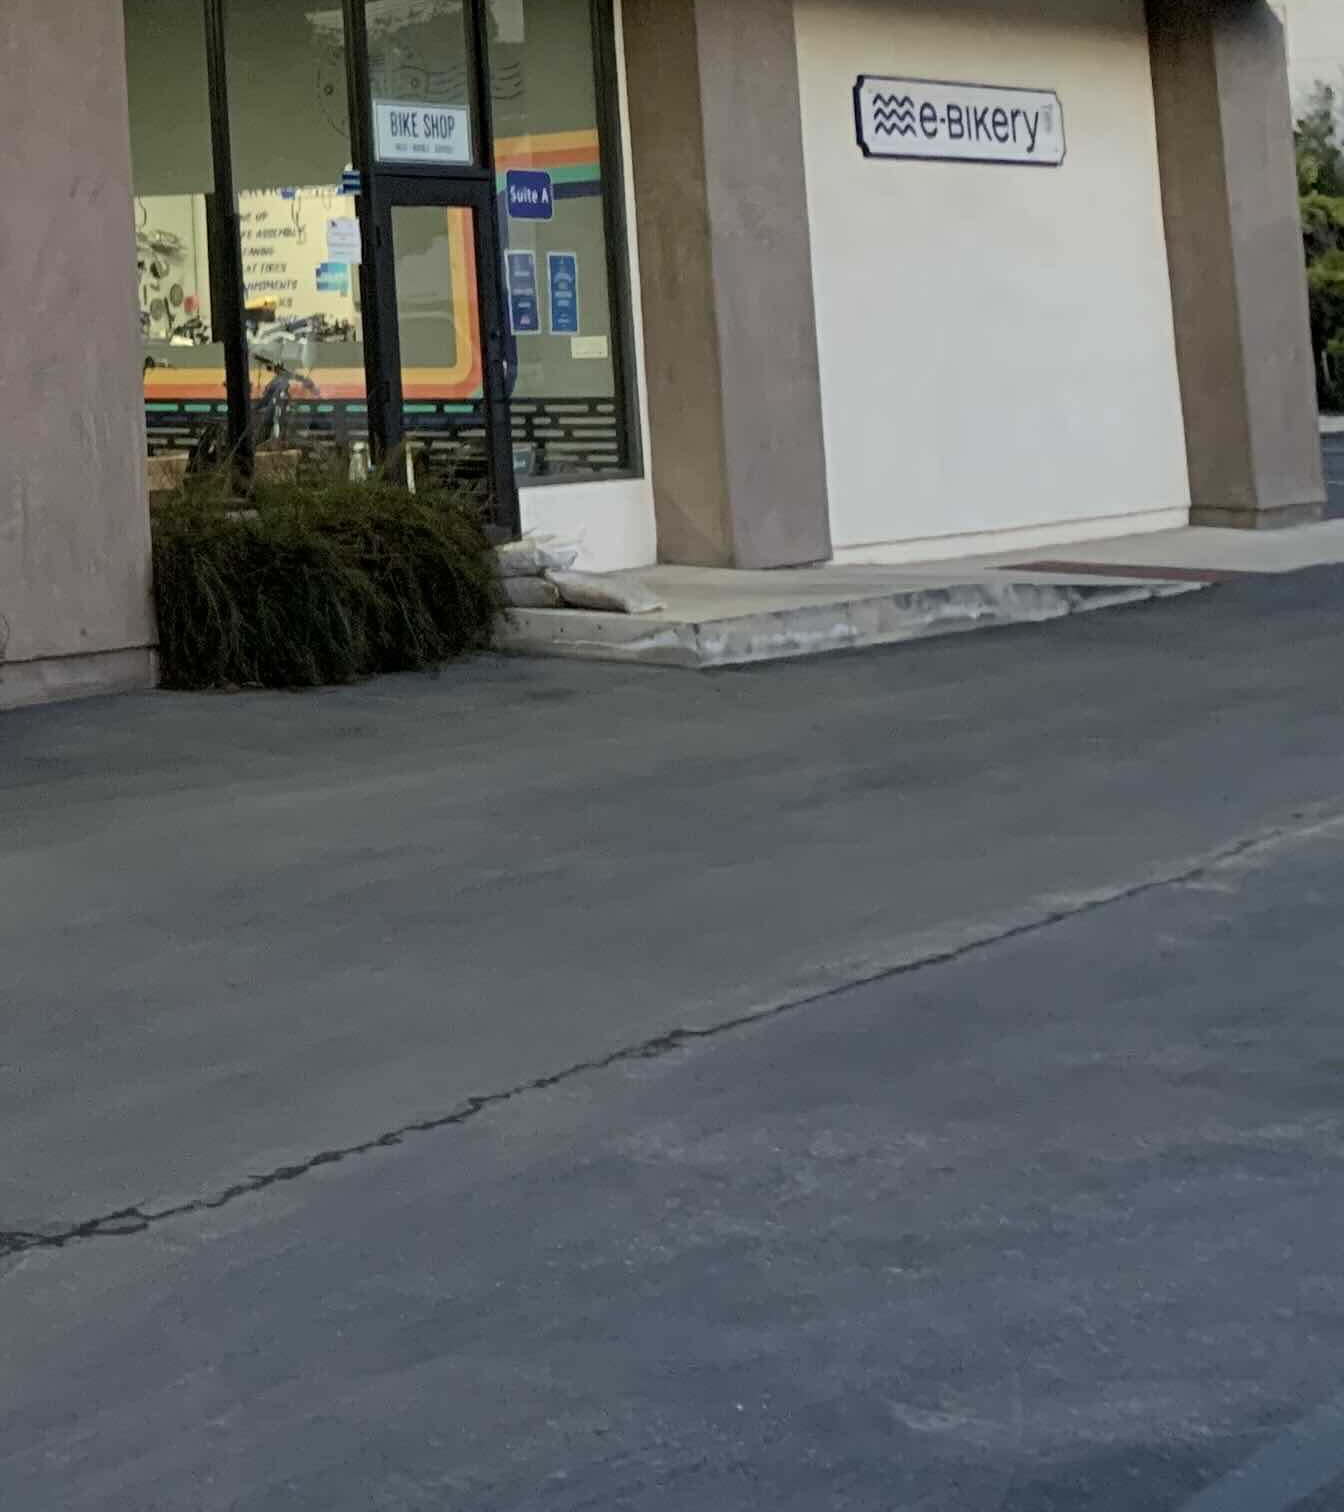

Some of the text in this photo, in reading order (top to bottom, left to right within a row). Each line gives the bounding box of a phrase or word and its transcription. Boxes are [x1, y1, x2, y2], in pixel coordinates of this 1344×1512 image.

[390, 111, 455, 140] BIKE SHOP
[510, 184, 550, 204] Suite A
